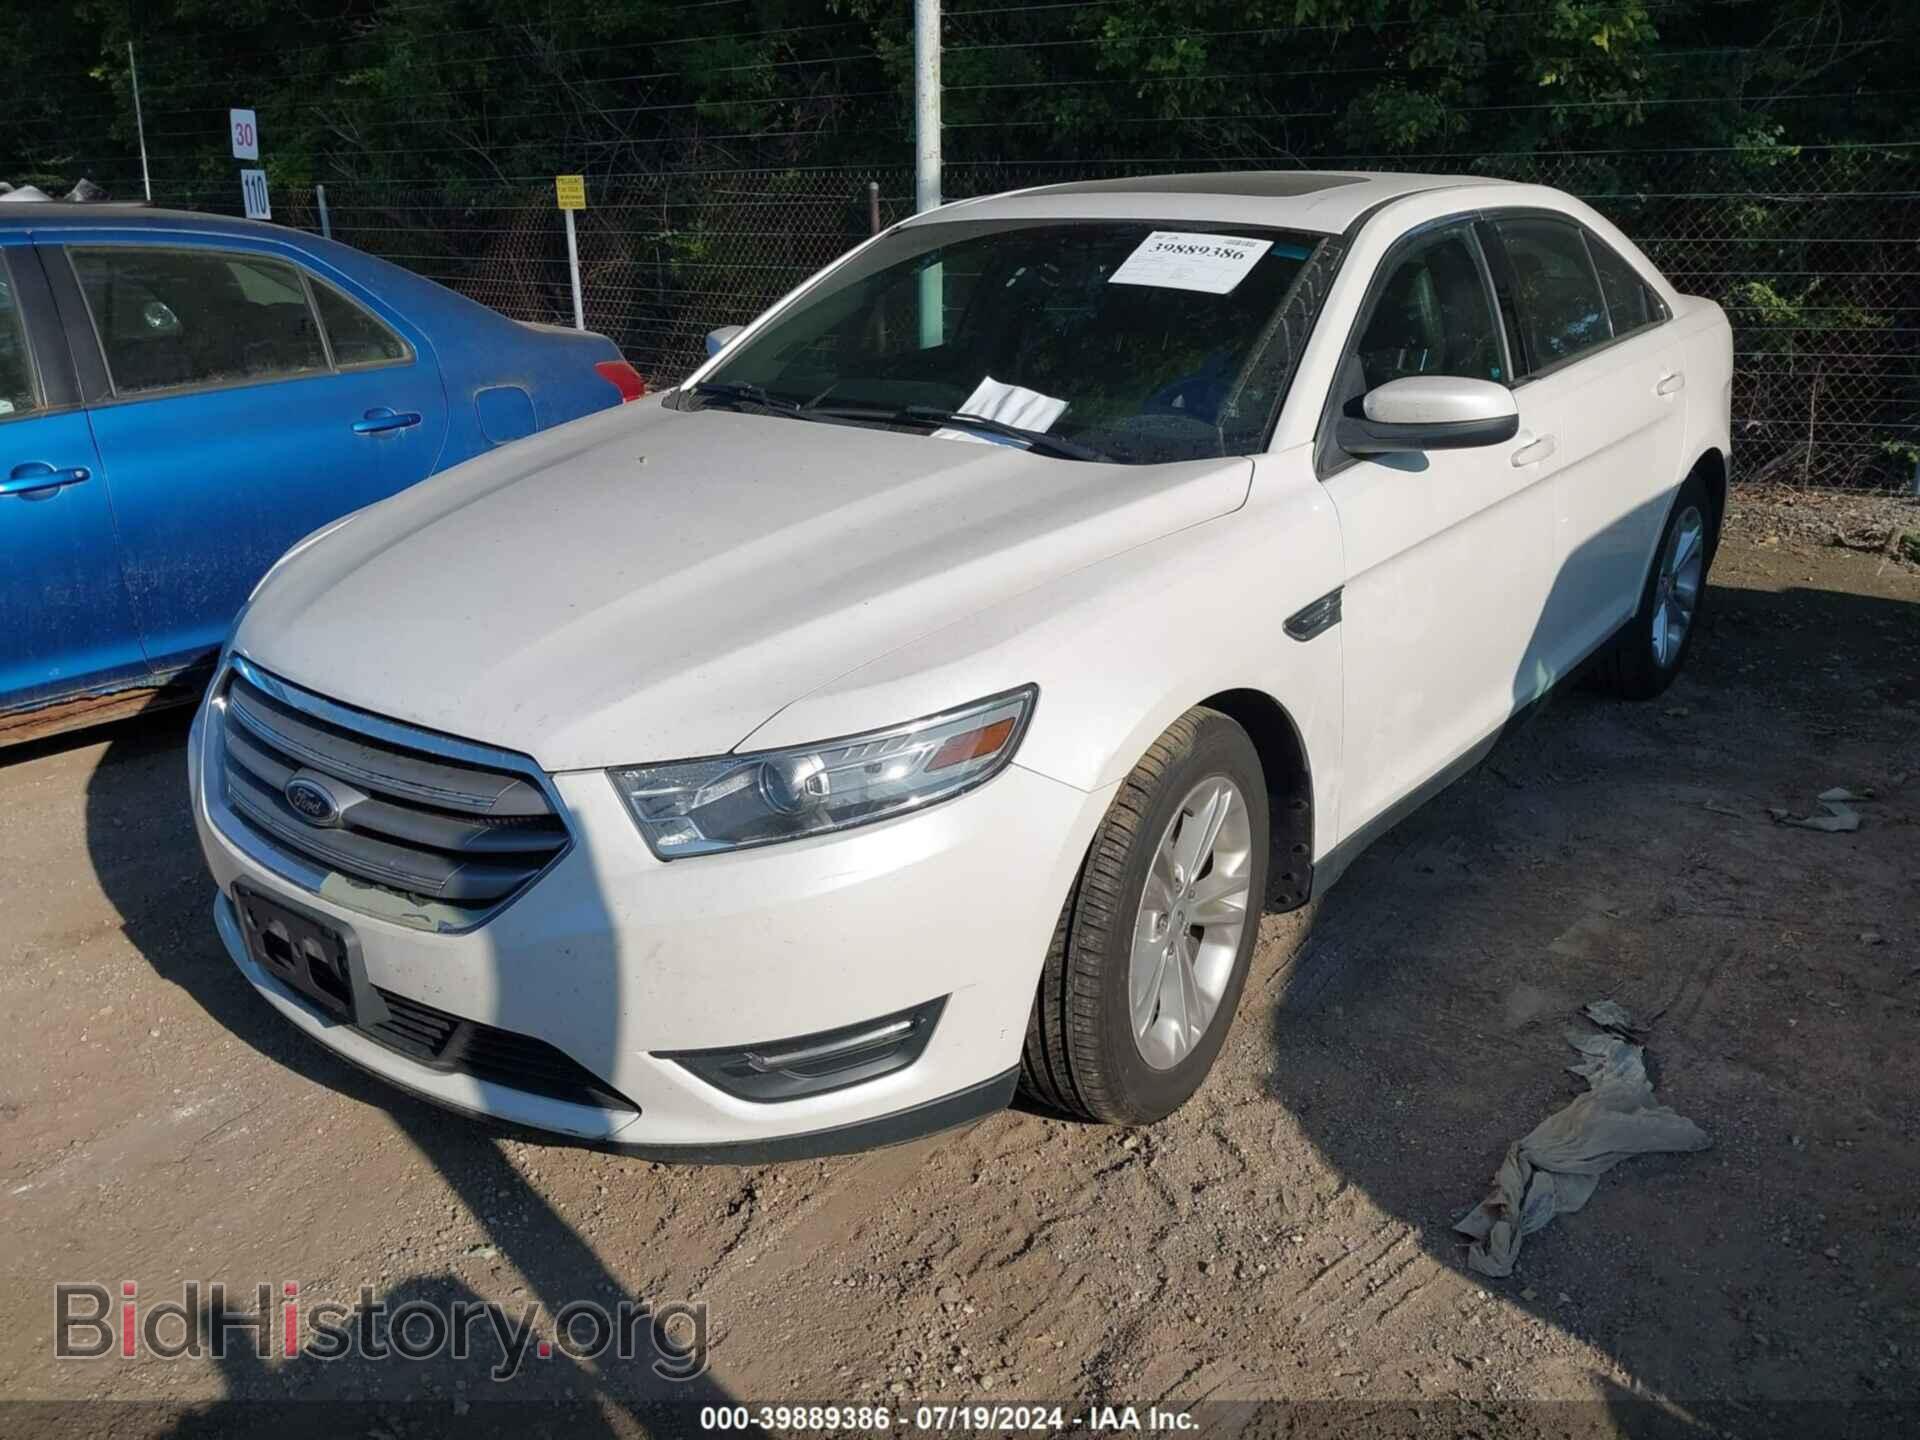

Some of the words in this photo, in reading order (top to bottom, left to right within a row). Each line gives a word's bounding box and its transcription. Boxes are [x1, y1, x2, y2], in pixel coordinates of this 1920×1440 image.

[236, 123, 253, 146] 30
[245, 175, 266, 214] 110
[1148, 242, 1246, 261] 39889386
